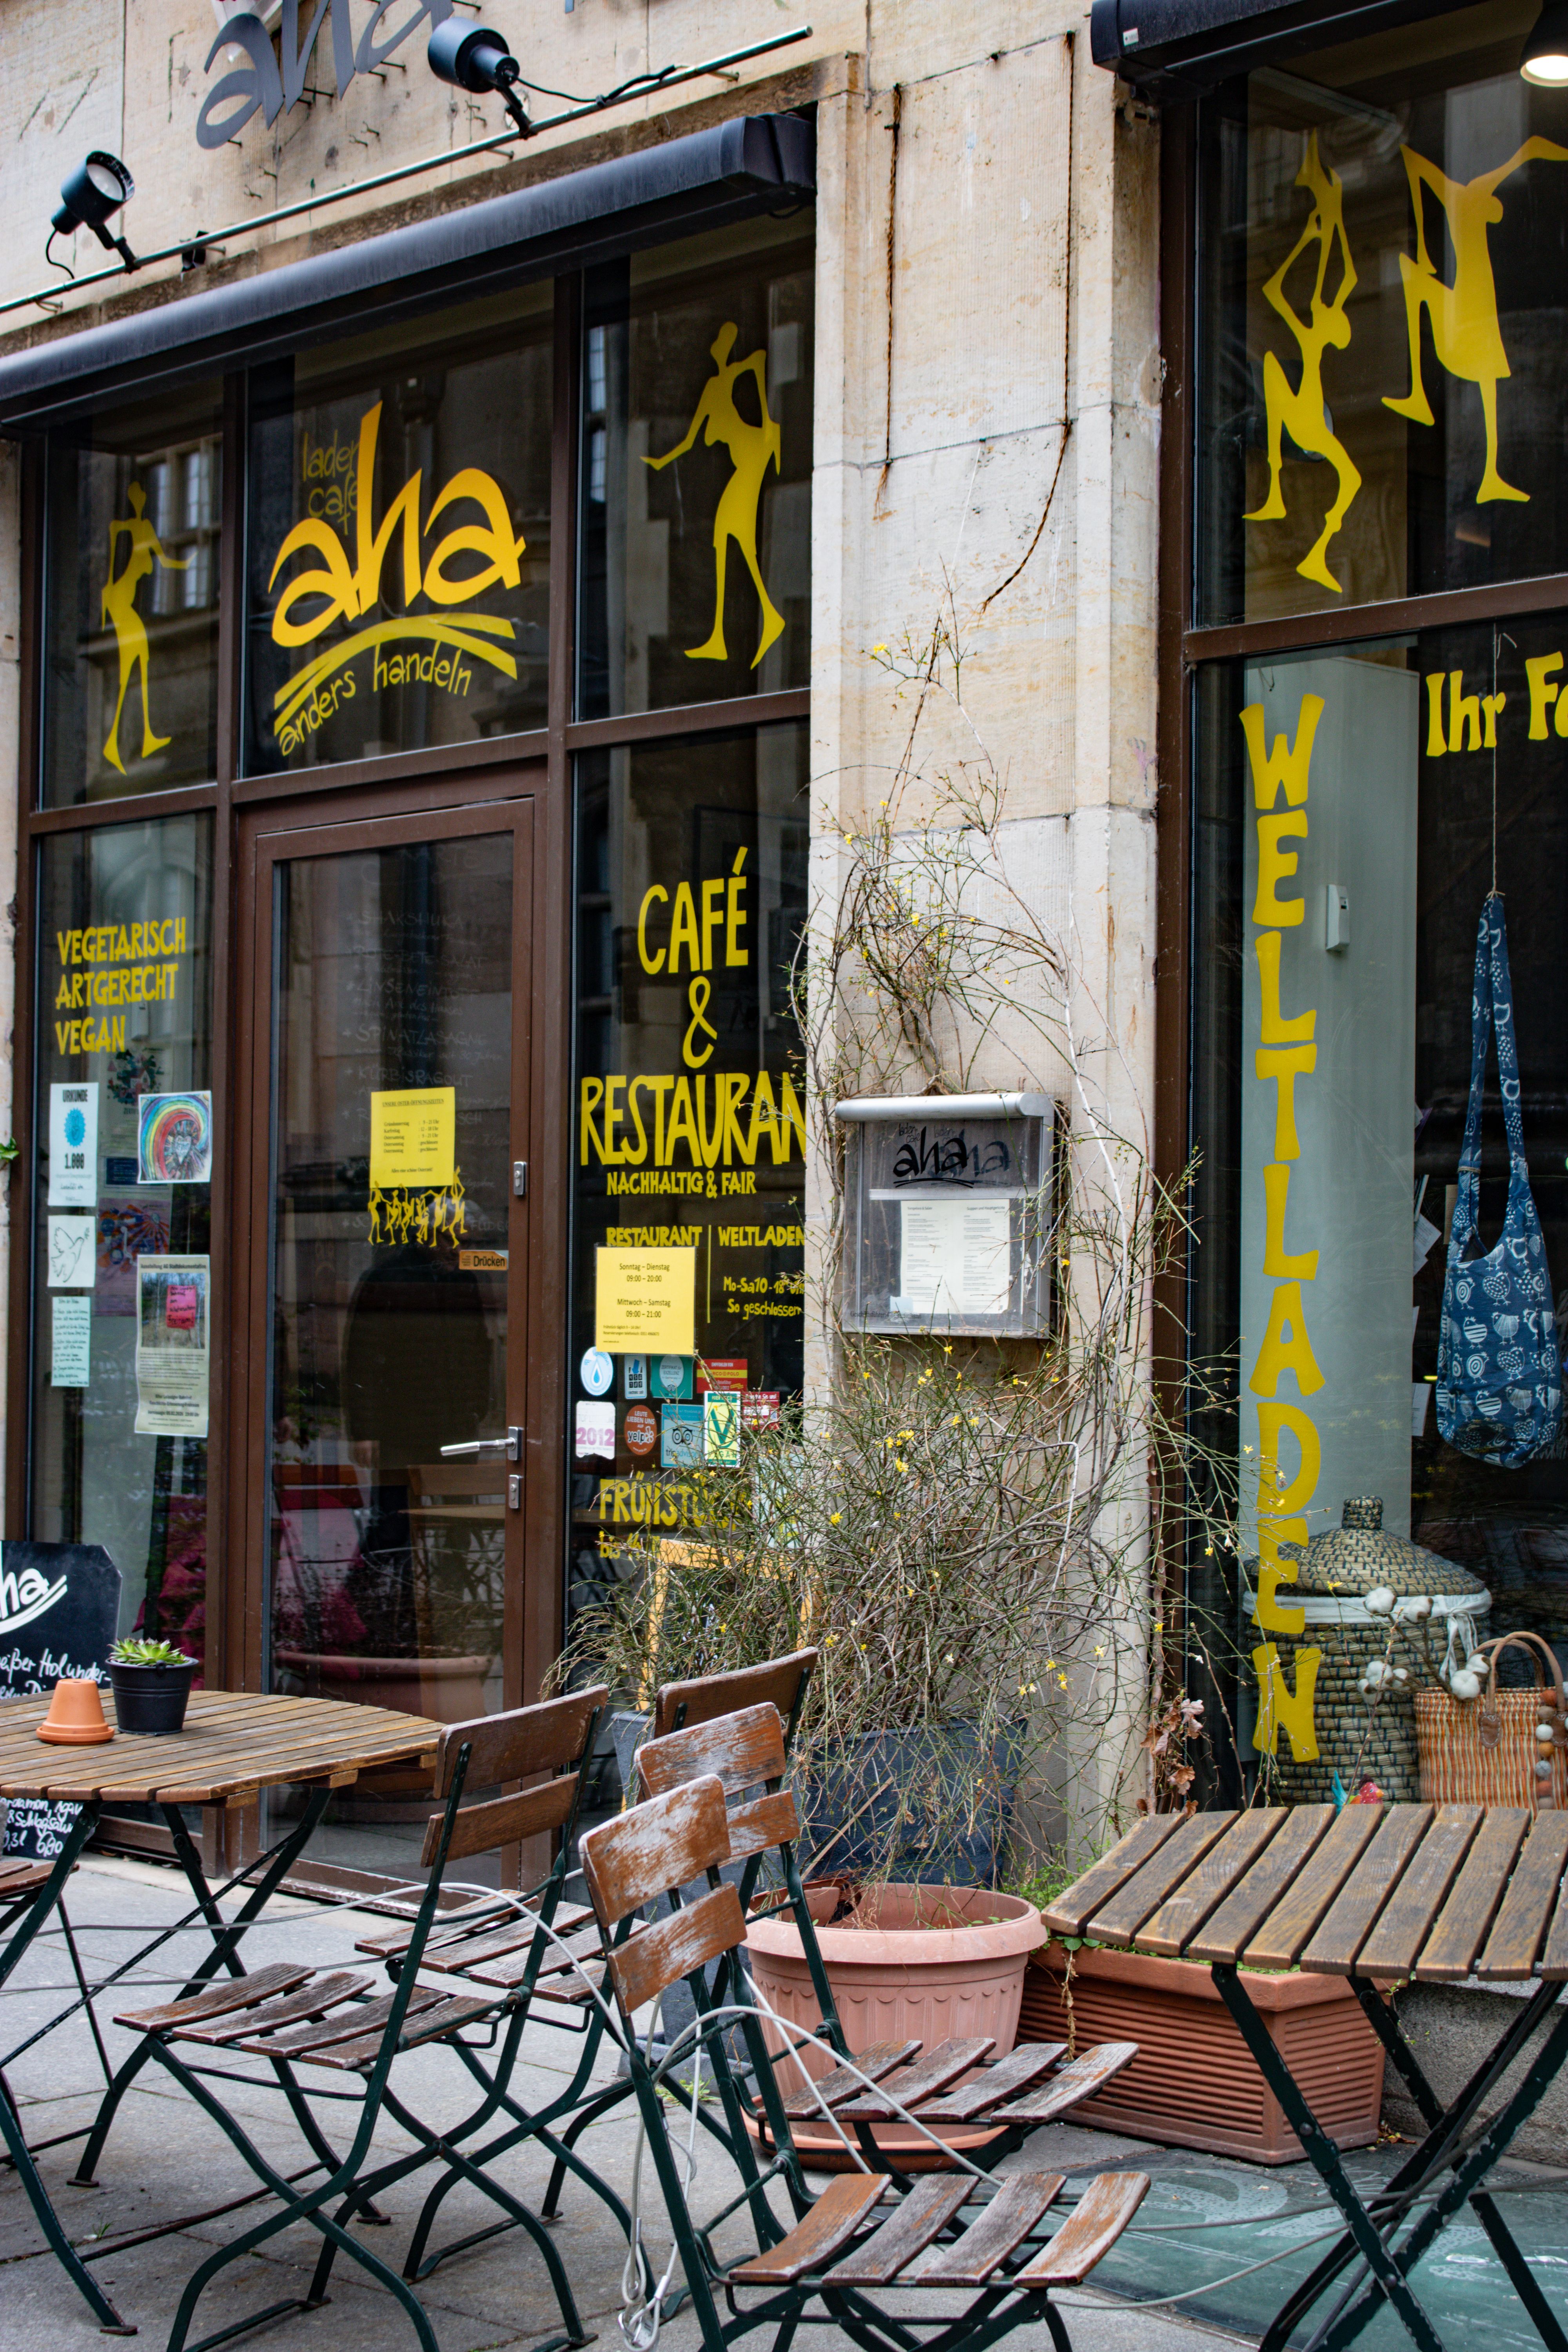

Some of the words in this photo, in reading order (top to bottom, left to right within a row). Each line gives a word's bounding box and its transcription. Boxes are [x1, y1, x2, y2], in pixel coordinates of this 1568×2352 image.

[267, 399, 526, 648] aha
[373, 642, 472, 697] handeln
[279, 669, 356, 757] anders
[1426, 670, 1506, 757] Ihr
[638, 846, 749, 975] CAFÉ
[57, 917, 186, 965] VEGETARISCH
[55, 963, 178, 1009] ARTGERECHT
[55, 1015, 125, 1055] VEGAN
[682, 976, 717, 1069] &
[63, 1089, 87, 1102] URKUNDE
[580, 1071, 806, 1168] RESTAURAN
[893, 1126, 969, 1177] aha
[607, 1171, 703, 1196] NACHHALTIG
[706, 1171, 717, 1198] &
[722, 1171, 757, 1195] FAIR
[606, 1225, 702, 1247] RESTAURANT
[1239, 693, 1326, 1762] WELTLADEN
[474, 1255, 505, 1267] Drücken
[619, 1263, 641, 1271] Sonntag
[647, 1263, 670, 1272] Dienstag
[648, 1299, 671, 1308] Samstag
[727, 1298, 740, 1313] So
[742, 1301, 802, 1320] geschlossen
[576, 1427, 615, 1446] 2012
[628, 1430, 646, 1445] yelp
[0, 1648, 36, 1684] eißer
[0, 1797, 52, 1818] ardamon,
